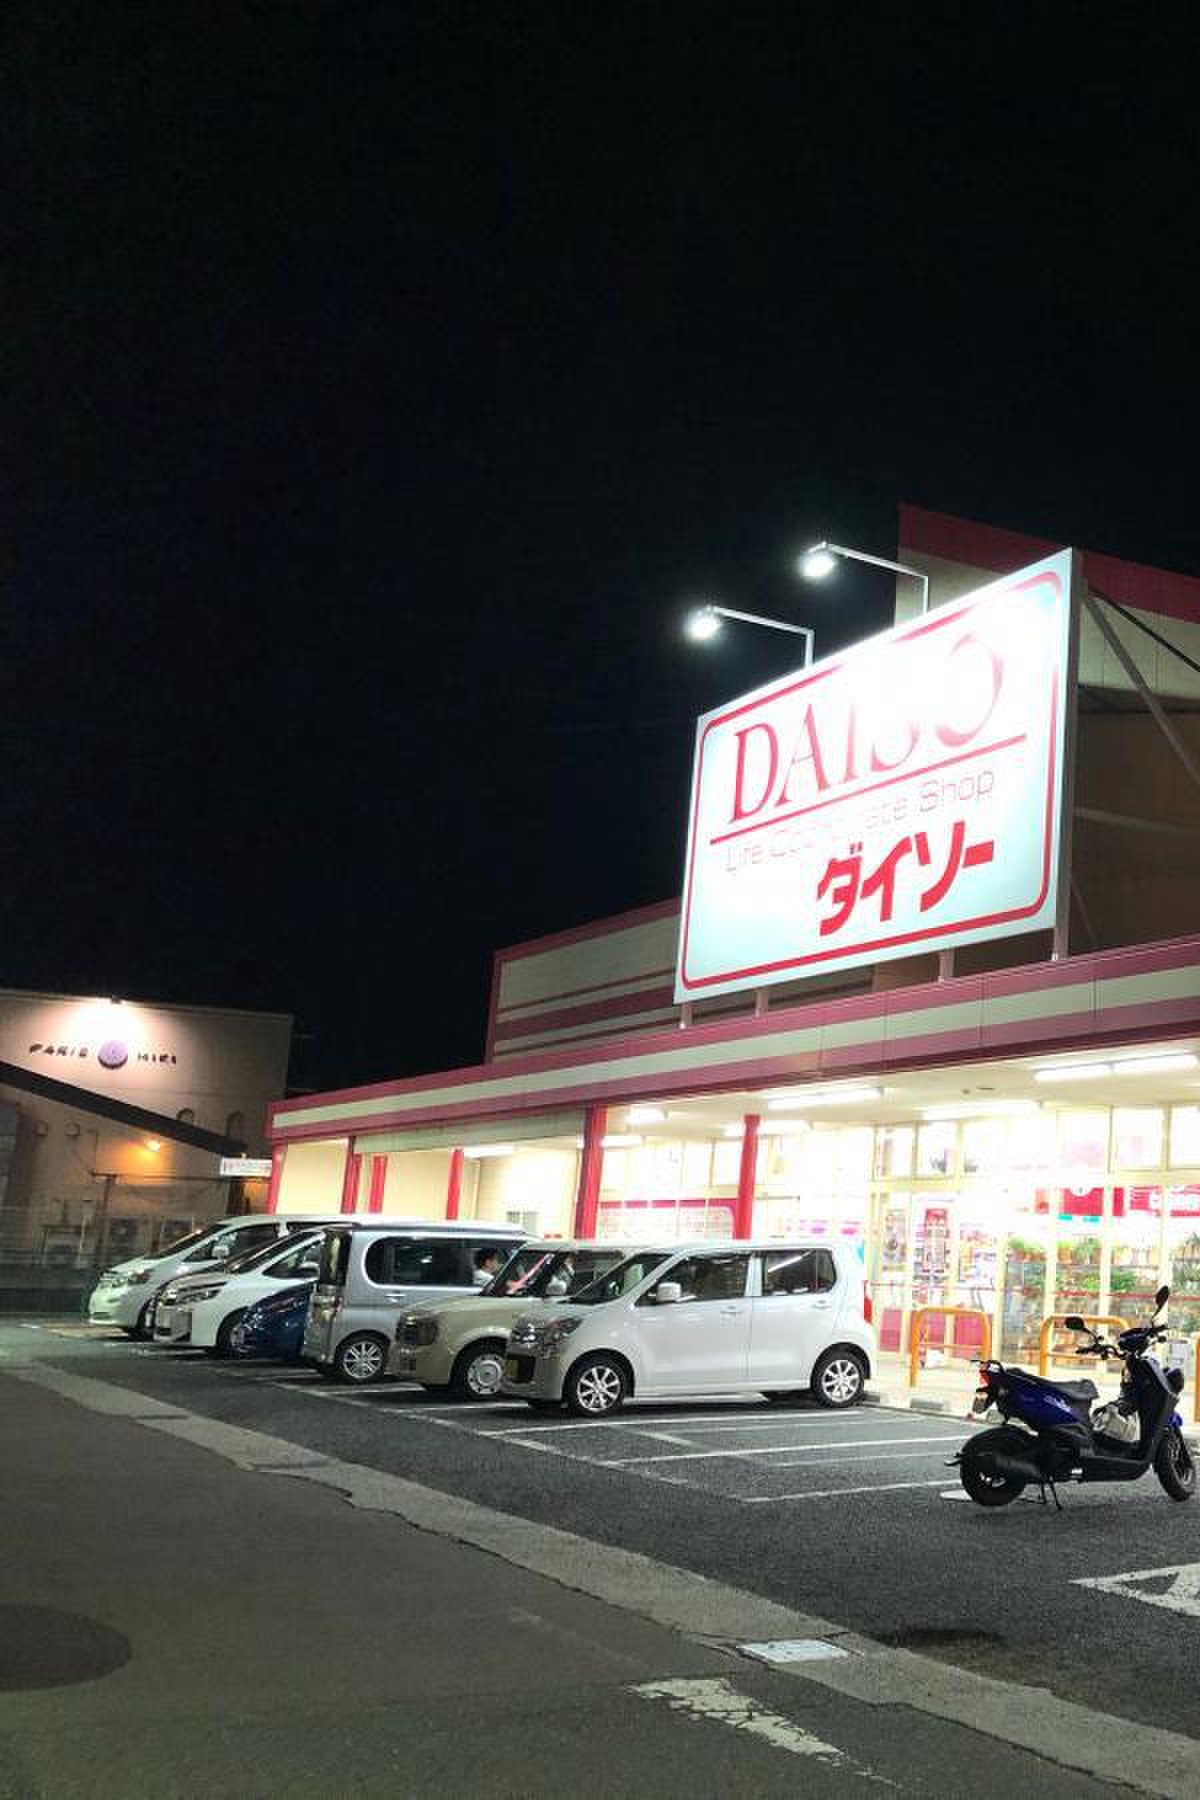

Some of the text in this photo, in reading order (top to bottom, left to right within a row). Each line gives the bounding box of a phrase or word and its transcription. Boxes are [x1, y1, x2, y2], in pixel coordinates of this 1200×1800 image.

[919, 771, 995, 813] Shop
[817, 820, 995, 937] ダイソー
